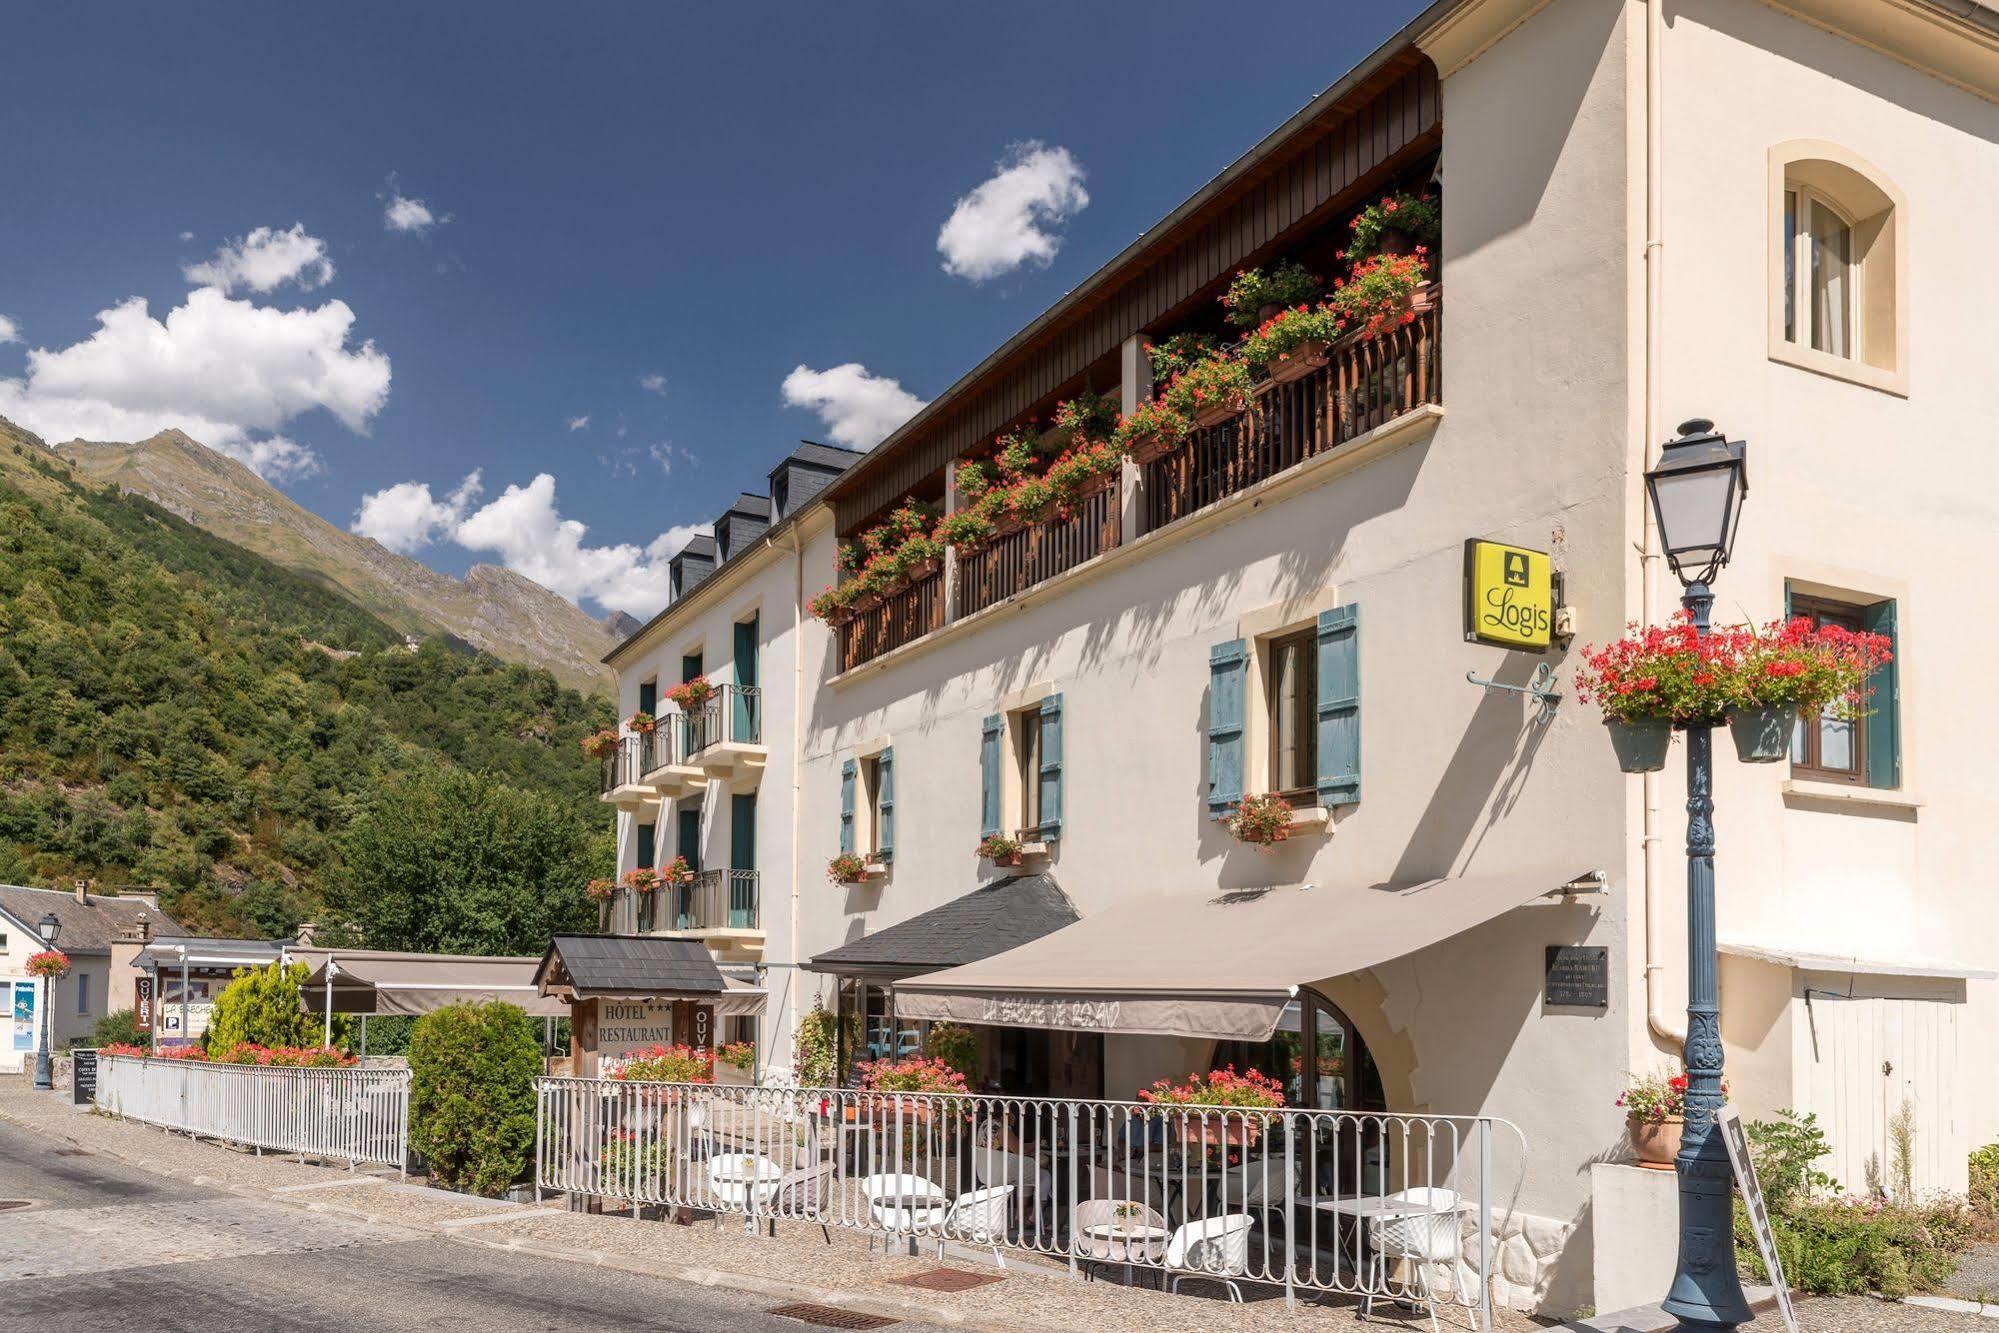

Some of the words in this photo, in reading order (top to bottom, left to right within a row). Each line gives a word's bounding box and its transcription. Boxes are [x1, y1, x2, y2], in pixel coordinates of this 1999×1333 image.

[1484, 587, 1549, 638] Logis
[139, 980, 151, 1023] OUVERT
[605, 1001, 646, 1020] HÔTEL
[982, 997, 997, 1021] LA
[599, 1027, 671, 1043] RESTAURANT
